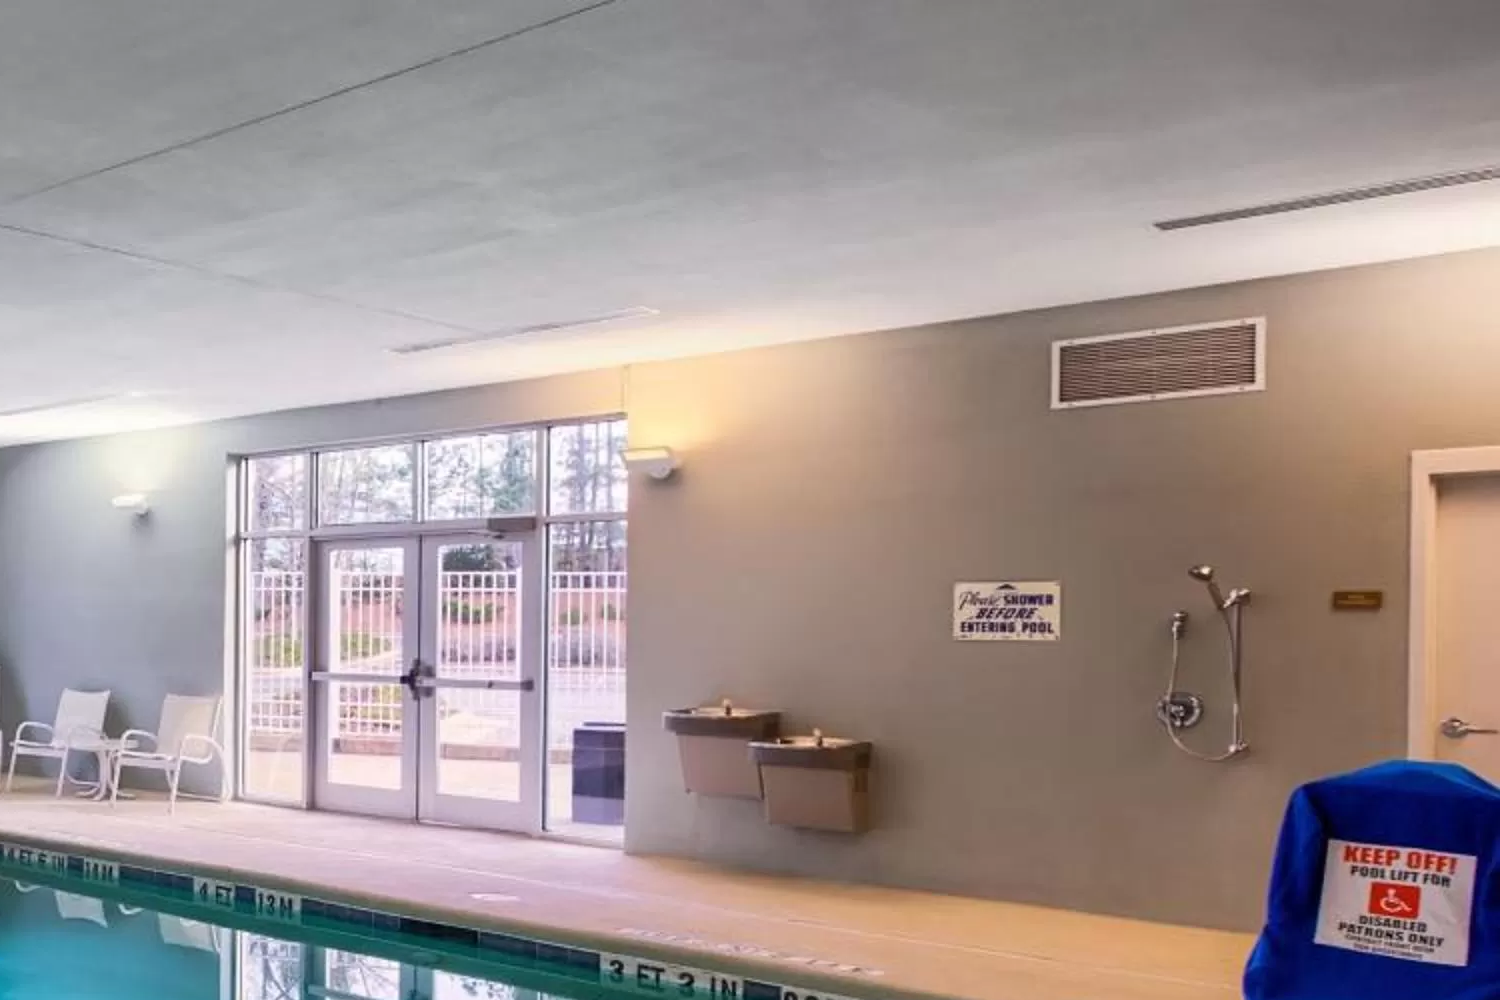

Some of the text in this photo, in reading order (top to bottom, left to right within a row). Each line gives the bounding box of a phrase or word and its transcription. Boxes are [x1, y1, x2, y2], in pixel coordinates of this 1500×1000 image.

[1003, 593, 1054, 606] SHOWER
[975, 607, 1039, 619] BEFORE
[960, 621, 1054, 634] ENTERING POOL
[1343, 844, 1458, 876] KEEP OFF!
[1350, 865, 1452, 888] POOL LIFT FOR
[1359, 915, 1428, 933] DISABLED
[1338, 921, 1404, 943] PATRONS
[1408, 933, 1445, 947] ONLY
